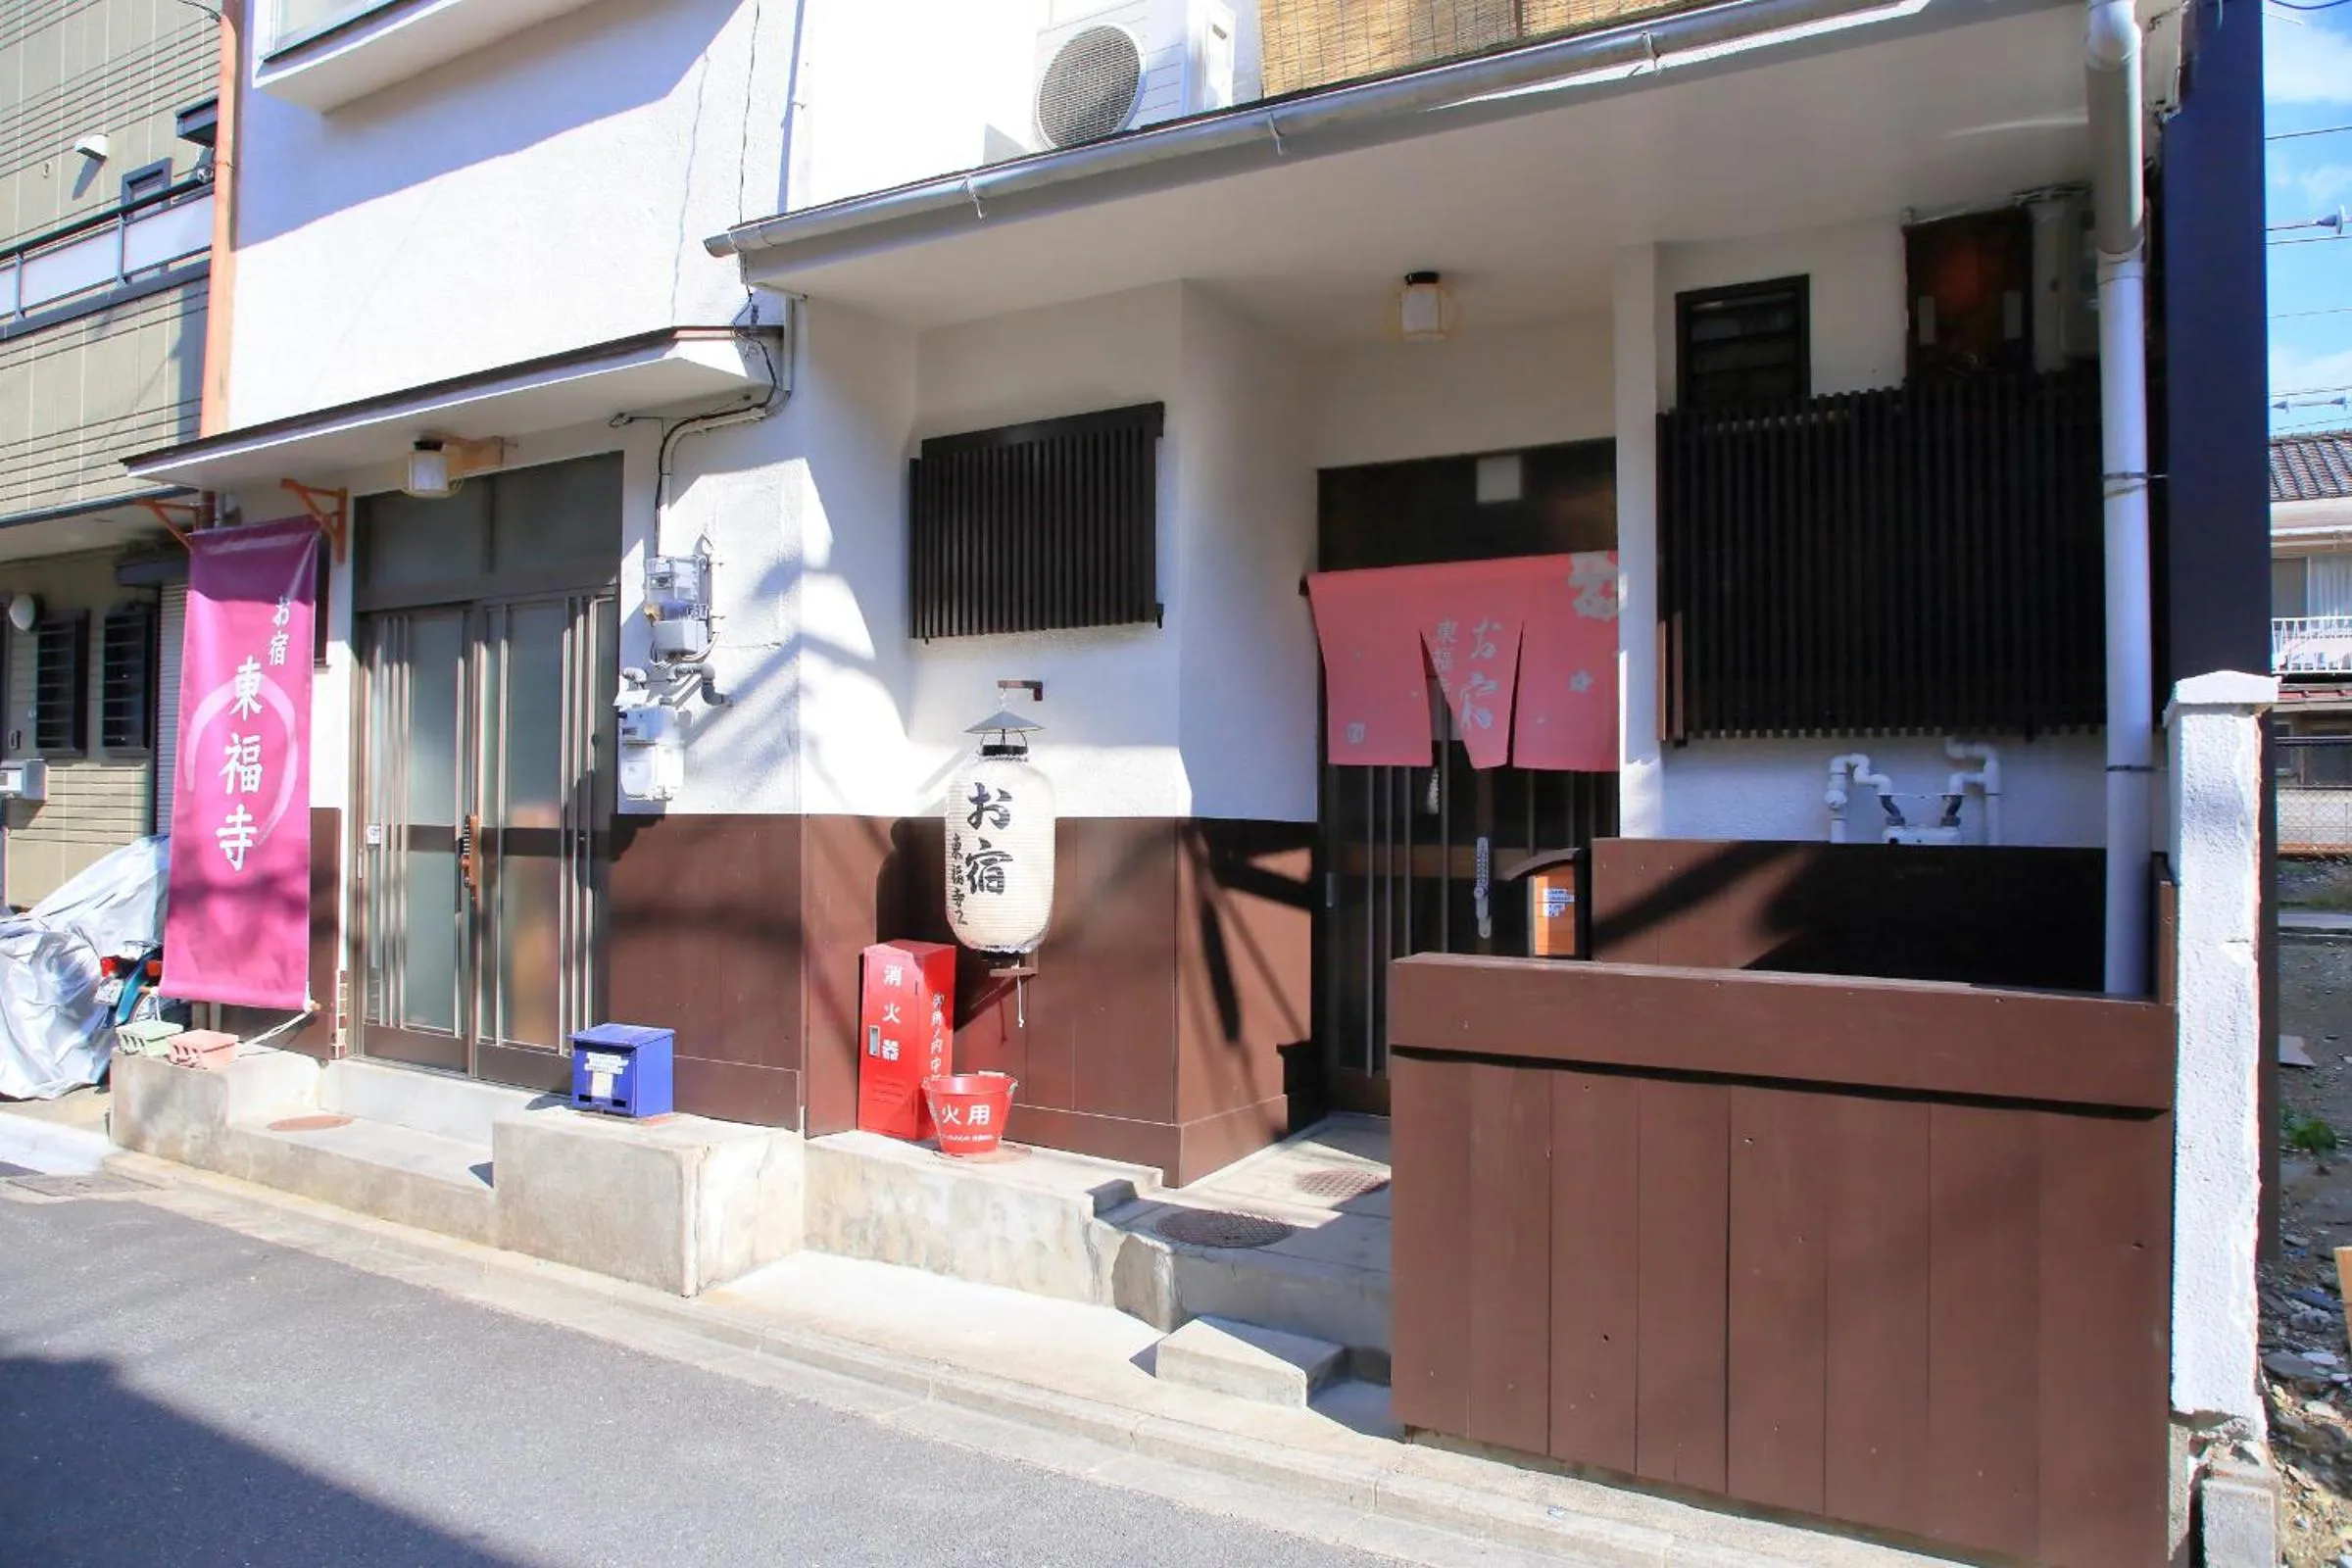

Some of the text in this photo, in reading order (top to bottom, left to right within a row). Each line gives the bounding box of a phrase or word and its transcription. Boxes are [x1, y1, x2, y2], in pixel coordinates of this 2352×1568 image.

[269, 595, 291, 666] お宿
[215, 654, 264, 872] 東福寺
[964, 781, 1013, 896] お宿
[881, 963, 903, 1062] 消火器
